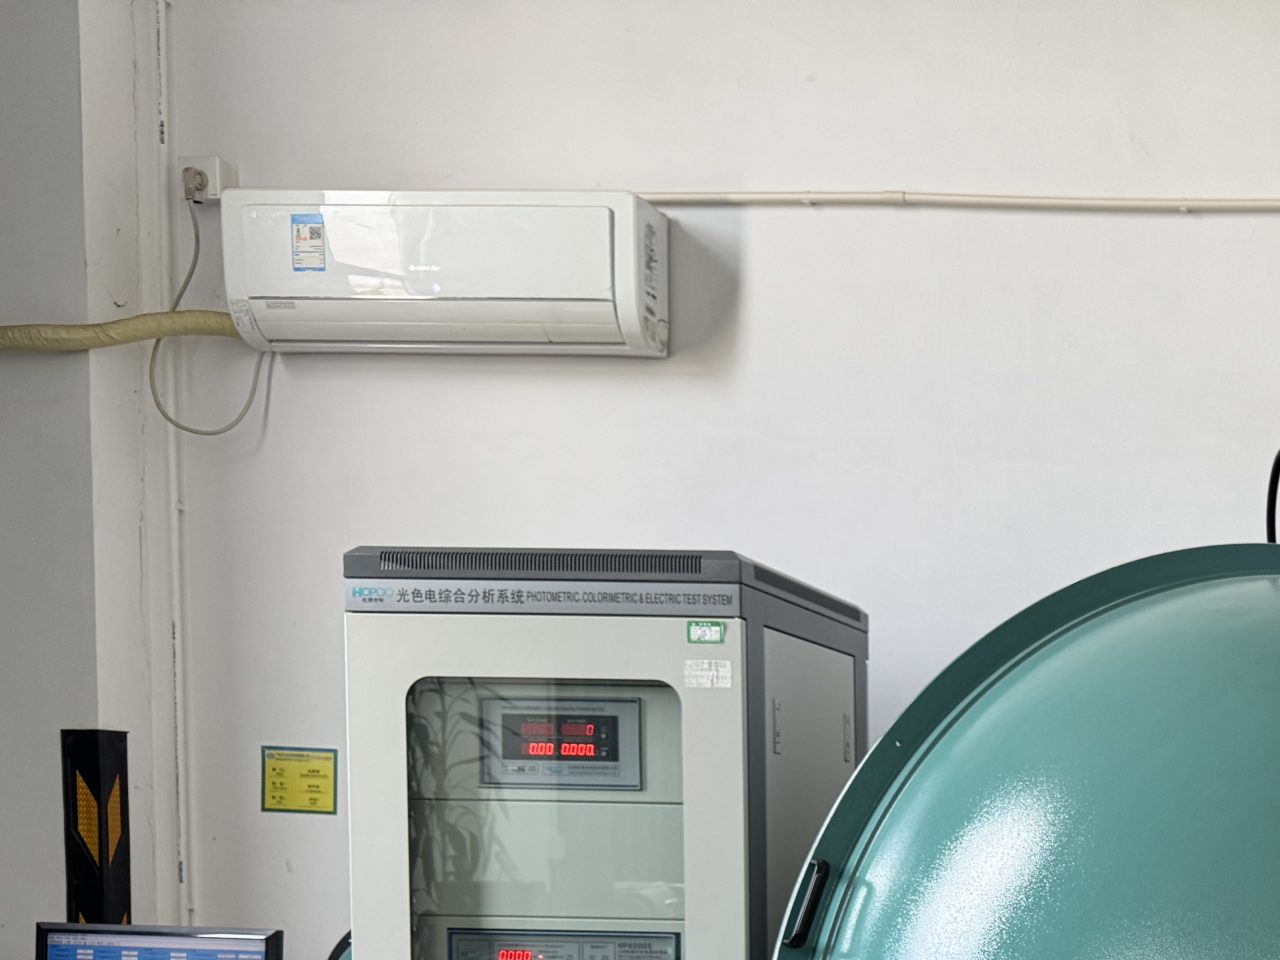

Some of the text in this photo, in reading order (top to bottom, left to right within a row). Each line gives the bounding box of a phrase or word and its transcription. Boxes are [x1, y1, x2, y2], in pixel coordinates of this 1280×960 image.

[397, 587, 525, 604] 光色电综合分析系统
[582, 592, 638, 604] COLORIMETRIC
[645, 593, 682, 605] ELECTRIC
[682, 594, 701, 605] TEST
[702, 594, 733, 605] SYSTEM
